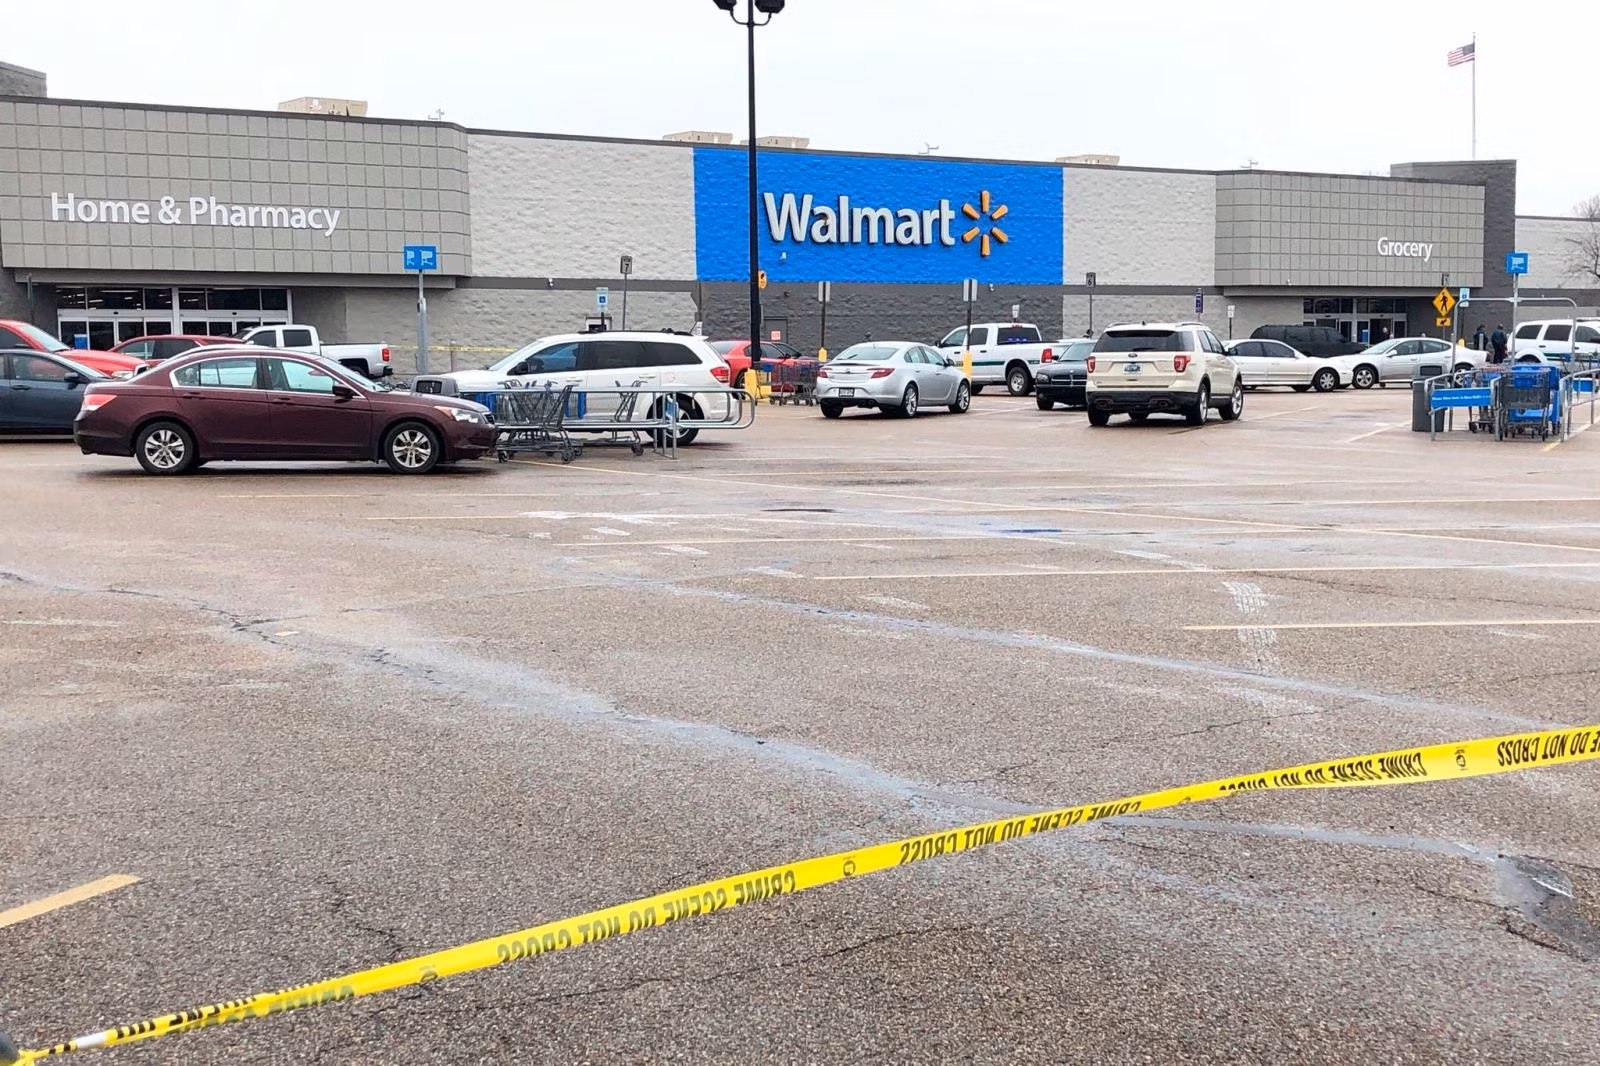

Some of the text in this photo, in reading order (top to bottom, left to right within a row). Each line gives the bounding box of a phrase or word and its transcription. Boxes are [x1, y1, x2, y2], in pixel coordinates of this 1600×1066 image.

[51, 192, 340, 237] Home & Pharmacy
[763, 193, 956, 246] Walmart
[1377, 237, 1433, 262] Grocery
[1497, 737, 1540, 767] CROSS
[1541, 734, 1569, 760] NOT
[1569, 731, 1591, 755] DO
[1328, 759, 1381, 783] SCENE
[1378, 753, 1427, 779] CRIME
